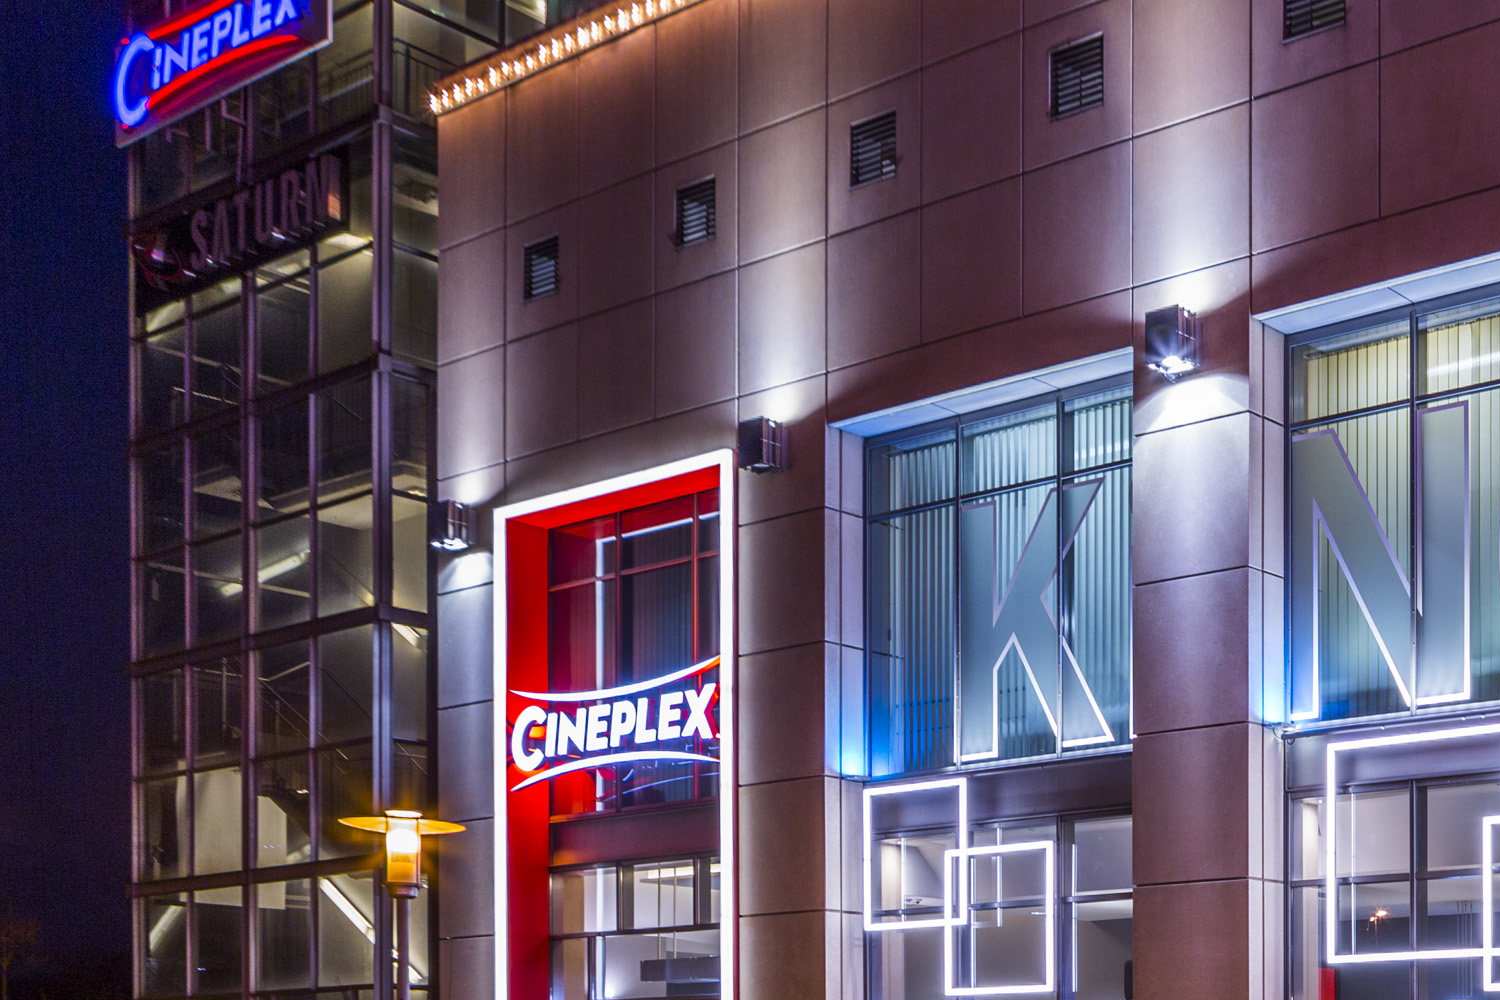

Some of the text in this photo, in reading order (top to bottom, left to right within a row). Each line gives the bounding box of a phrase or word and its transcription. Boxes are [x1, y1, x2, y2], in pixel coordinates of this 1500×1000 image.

[115, 0, 300, 127] CINEPLEX
[190, 156, 340, 272] SATURN
[511, 682, 717, 772] CINEPLEX
